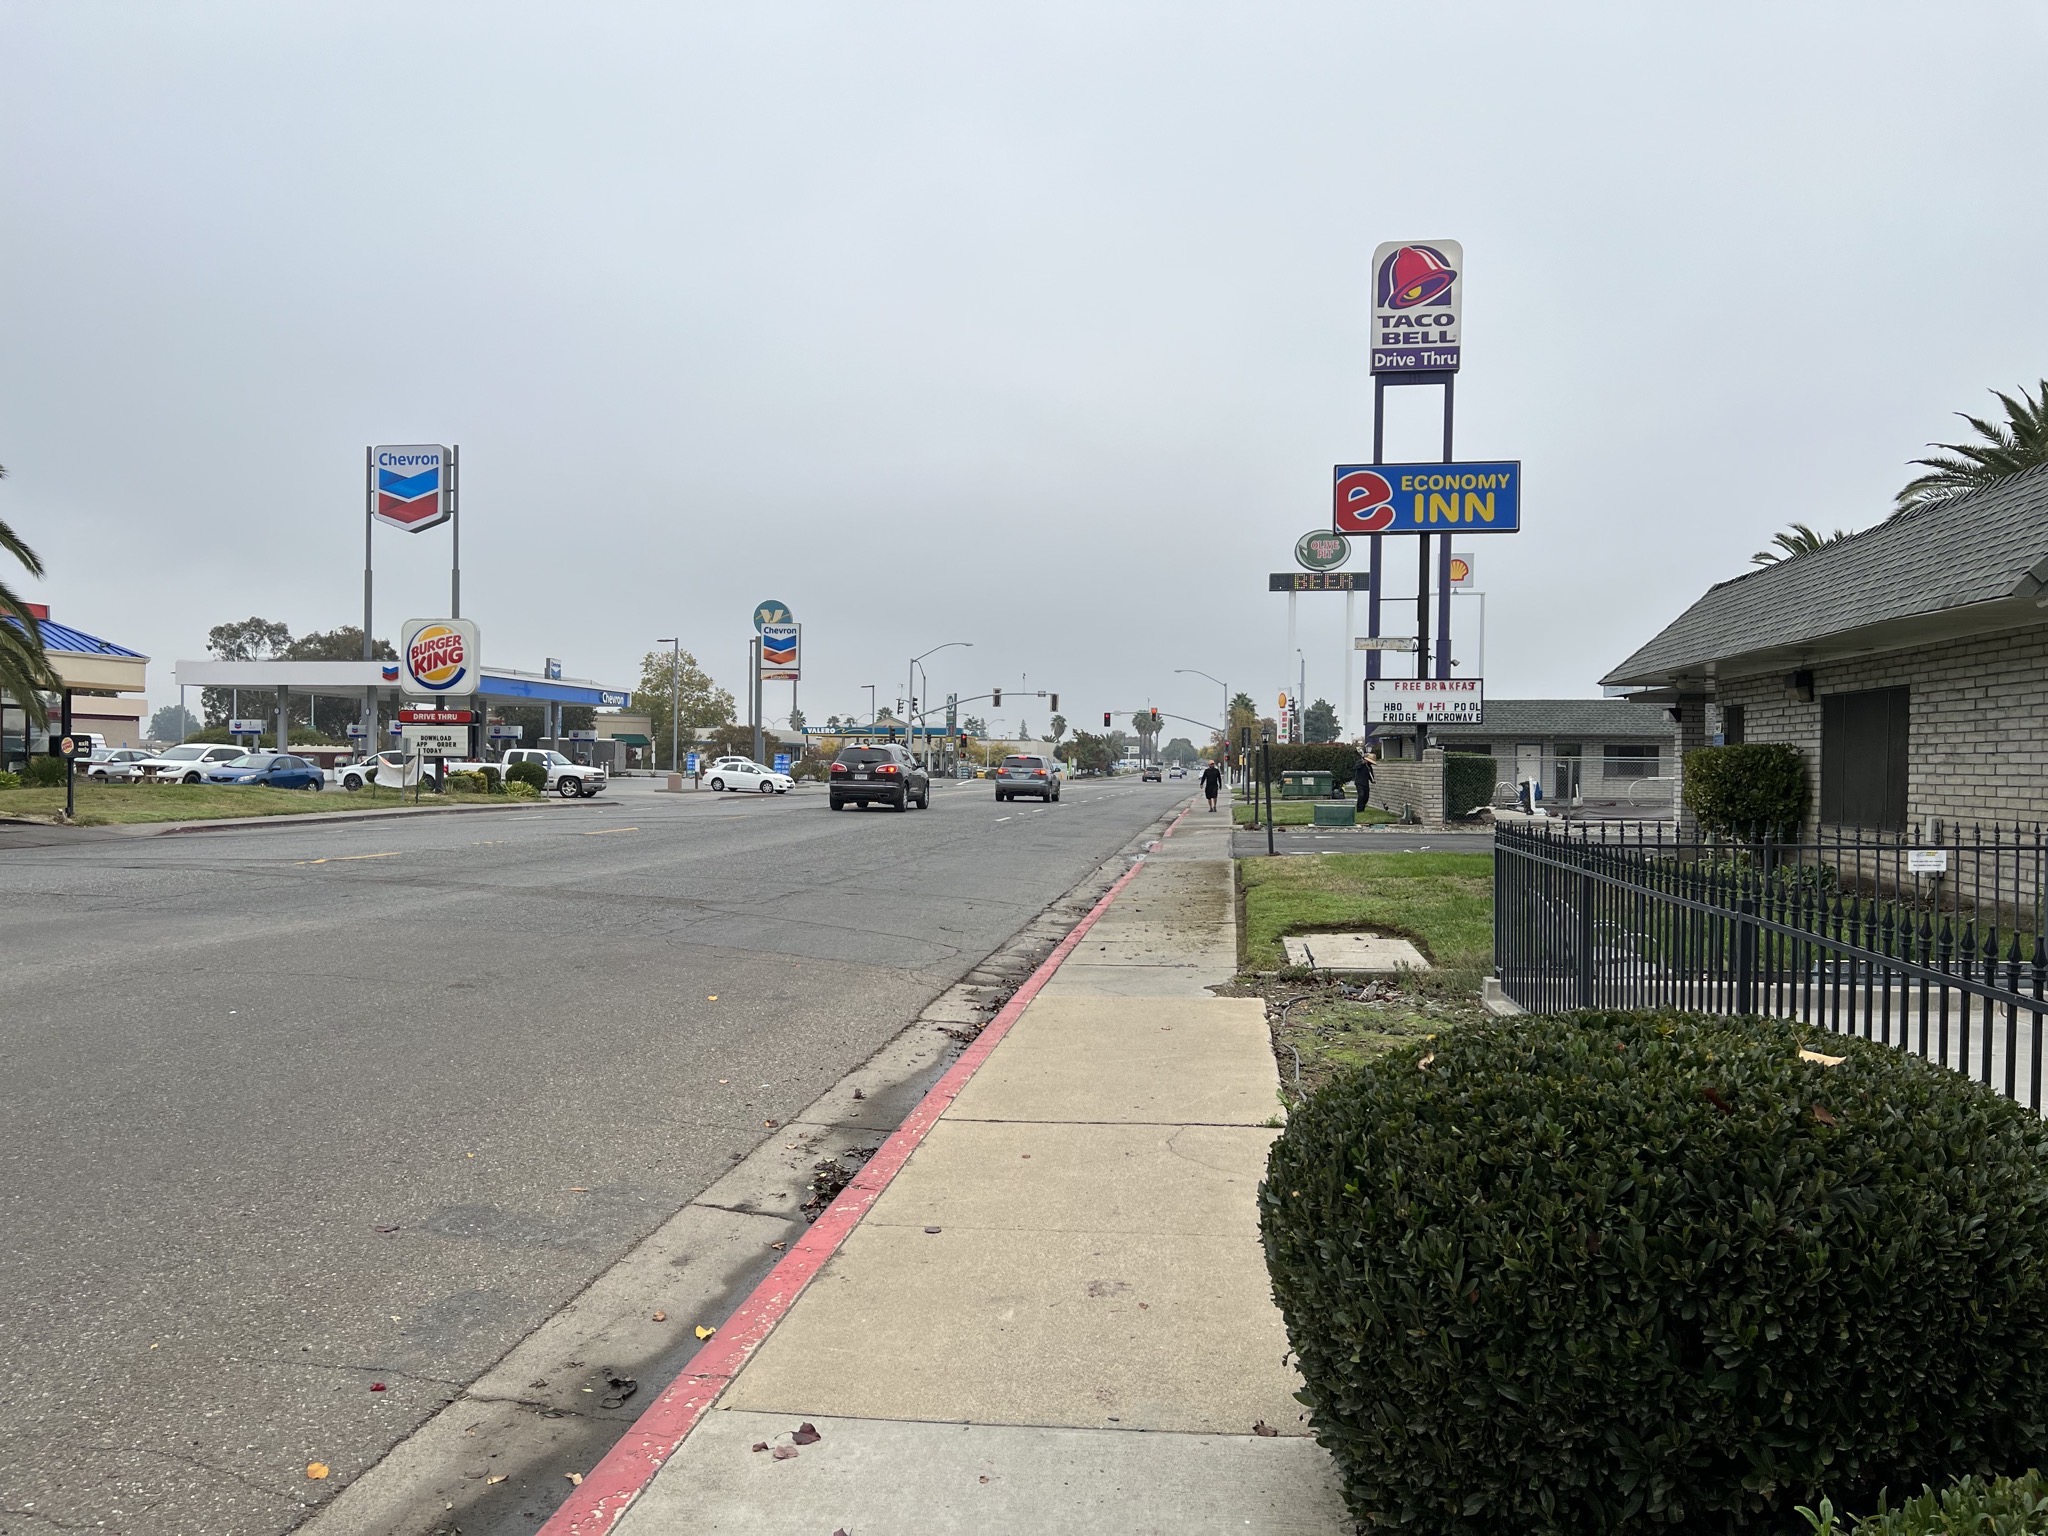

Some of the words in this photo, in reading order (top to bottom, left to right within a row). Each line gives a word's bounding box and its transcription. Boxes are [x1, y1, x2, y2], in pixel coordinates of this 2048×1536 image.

[1377, 313, 1455, 328] TACO
[1382, 330, 1457, 345] BELL
[1374, 352, 1416, 367] Drive
[1420, 350, 1457, 366] Thru
[379, 452, 439, 466] Chevron
[1401, 473, 1510, 491] ECONOMY
[1414, 492, 1495, 524] INN
[1310, 539, 1340, 550] OLIVE
[1316, 549, 1333, 558] PIT
[1294, 573, 1353, 589] BEER
[763, 626, 797, 635] Chevron
[411, 634, 462, 660] BURGER
[413, 646, 464, 678] KING
[1369, 682, 1375, 691] S
[1394, 682, 1421, 691] FREE
[602, 692, 624, 705] Chevron
[1384, 703, 1402, 711] HBO
[413, 713, 436, 721] DRIVE
[437, 713, 458, 721] THRU
[1383, 713, 1417, 721] FRIDGE
[1427, 713, 1481, 722] MICROWAVE
